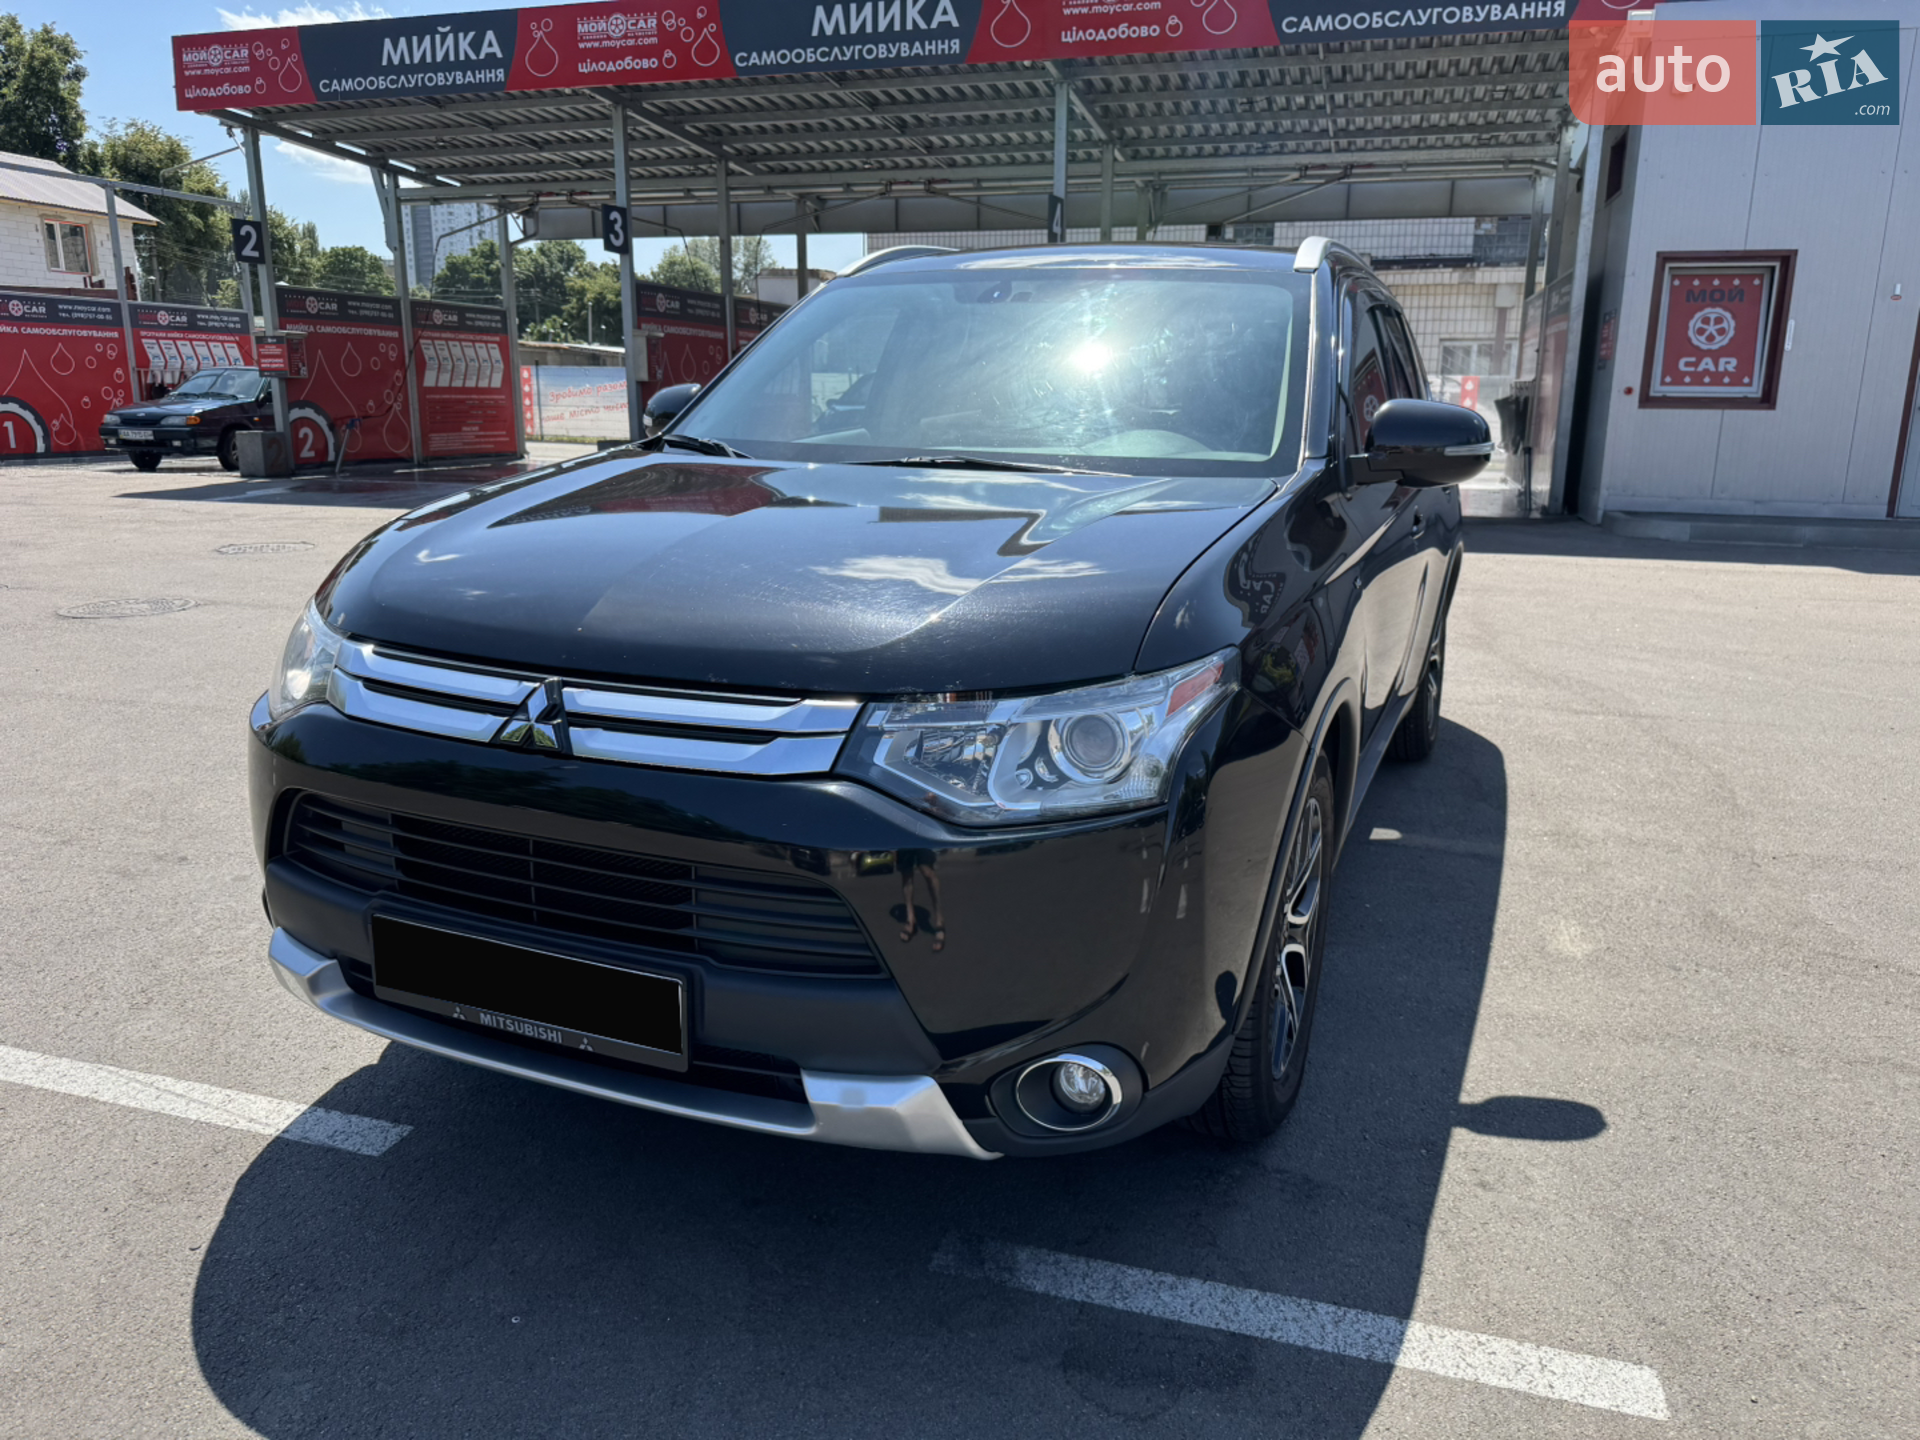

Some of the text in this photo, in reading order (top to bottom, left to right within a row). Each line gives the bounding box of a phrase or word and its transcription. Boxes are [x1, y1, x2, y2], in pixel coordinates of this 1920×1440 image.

[1062, 1, 1161, 15] www.moycar.com
[577, 18, 657, 33] МОЙ CAR
[1281, 0, 1566, 34] САМООБСЛУГОВУВАННЯ
[1061, 23, 1160, 43] цілодобово
[381, 25, 503, 66] МИЙКА
[578, 37, 658, 49] www.moycar.com
[223, 48, 249, 59] CAR
[734, 38, 960, 67] САМООБСЛУГОВУВАННЯ
[184, 66, 250, 76] www.moycar.com
[578, 56, 659, 74] цілодобово
[319, 68, 505, 93] САМООБСЛУГОВУВАННЯ
[184, 83, 252, 98] цілодобово
[609, 210, 624, 247] 3
[240, 224, 259, 258] 2
[1685, 286, 1745, 303] МОЙ
[24, 304, 47, 314] CAR
[319, 301, 338, 311] CAR
[170, 314, 188, 323] CAR
[1678, 357, 1737, 372] CAR
[549, 386, 592, 403] Зробимо
[3, 421, 17, 449] 1
[298, 426, 315, 458] 2
[479, 1012, 562, 1044] MITSUBISHI
